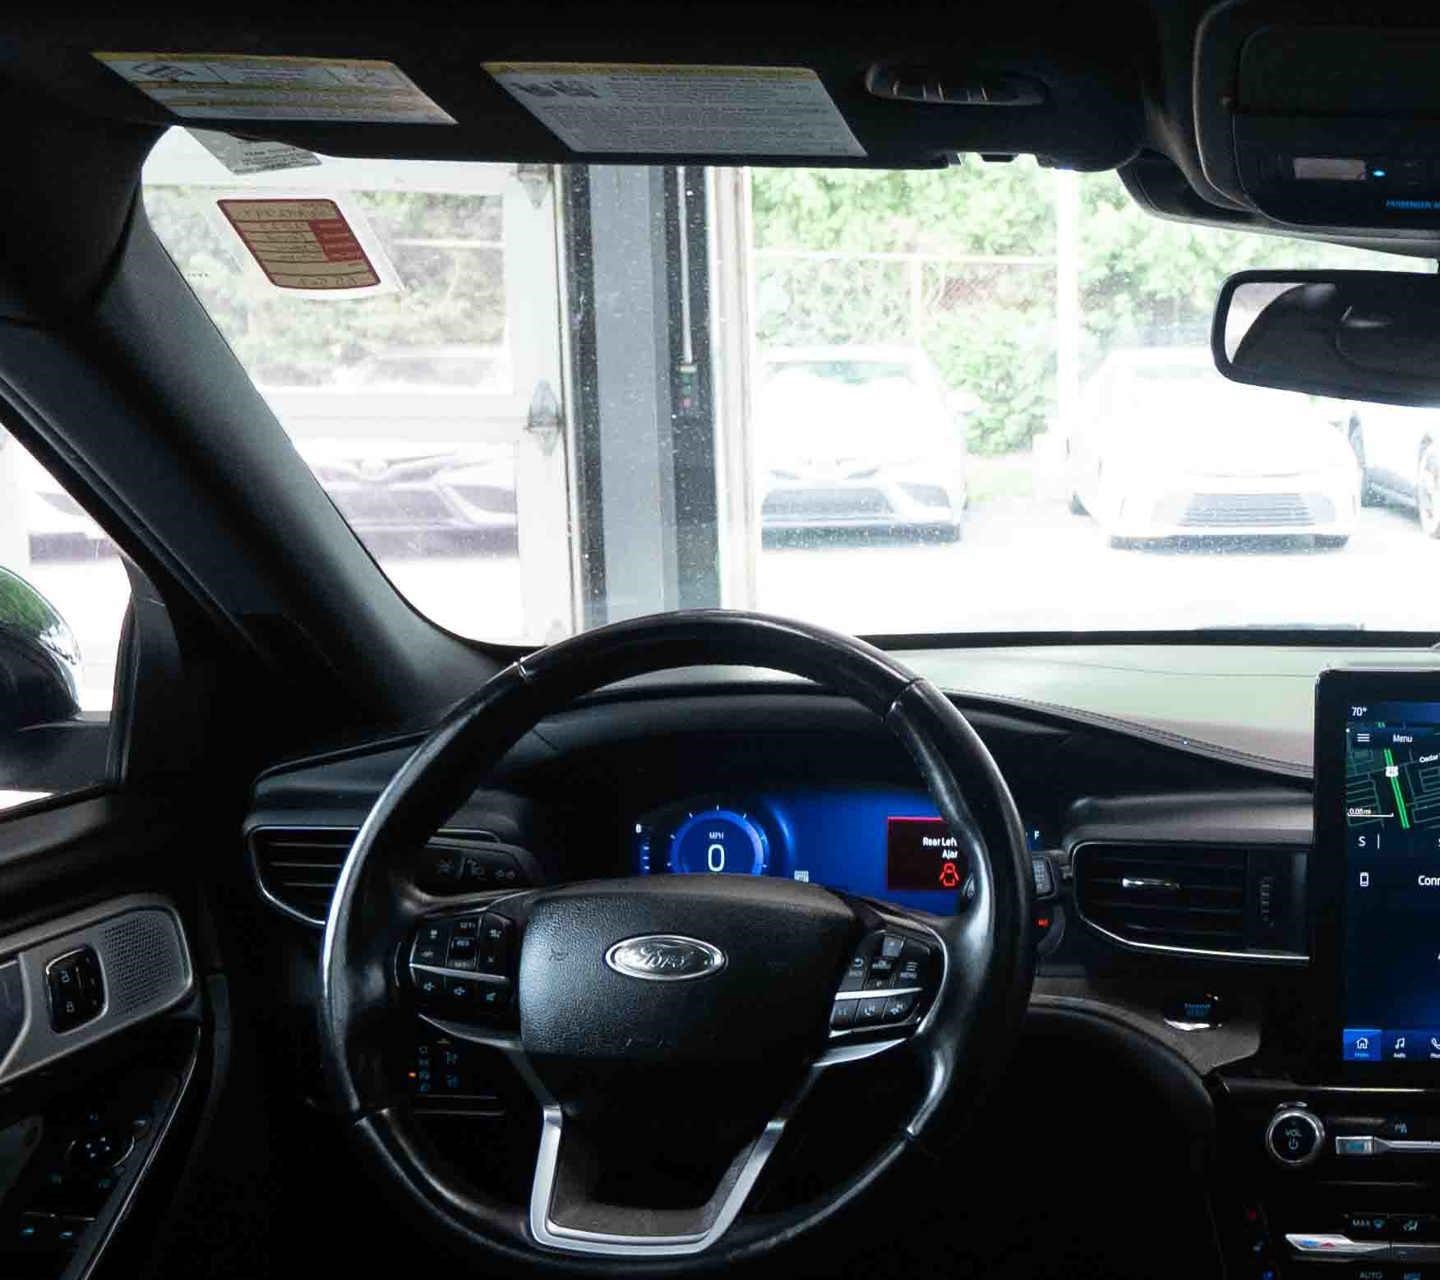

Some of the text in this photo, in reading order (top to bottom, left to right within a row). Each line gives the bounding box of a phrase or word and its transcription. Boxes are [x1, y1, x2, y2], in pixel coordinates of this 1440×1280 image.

[1392, 733, 1413, 743] Menu
[709, 831, 724, 840] MPH
[1034, 830, 1040, 840] F
[922, 836, 940, 847] Rear
[1358, 835, 1366, 847] S
[707, 843, 725, 872] 0
[1284, 1128, 1303, 1138] VOL
[1359, 1271, 1384, 1280] AUTO
